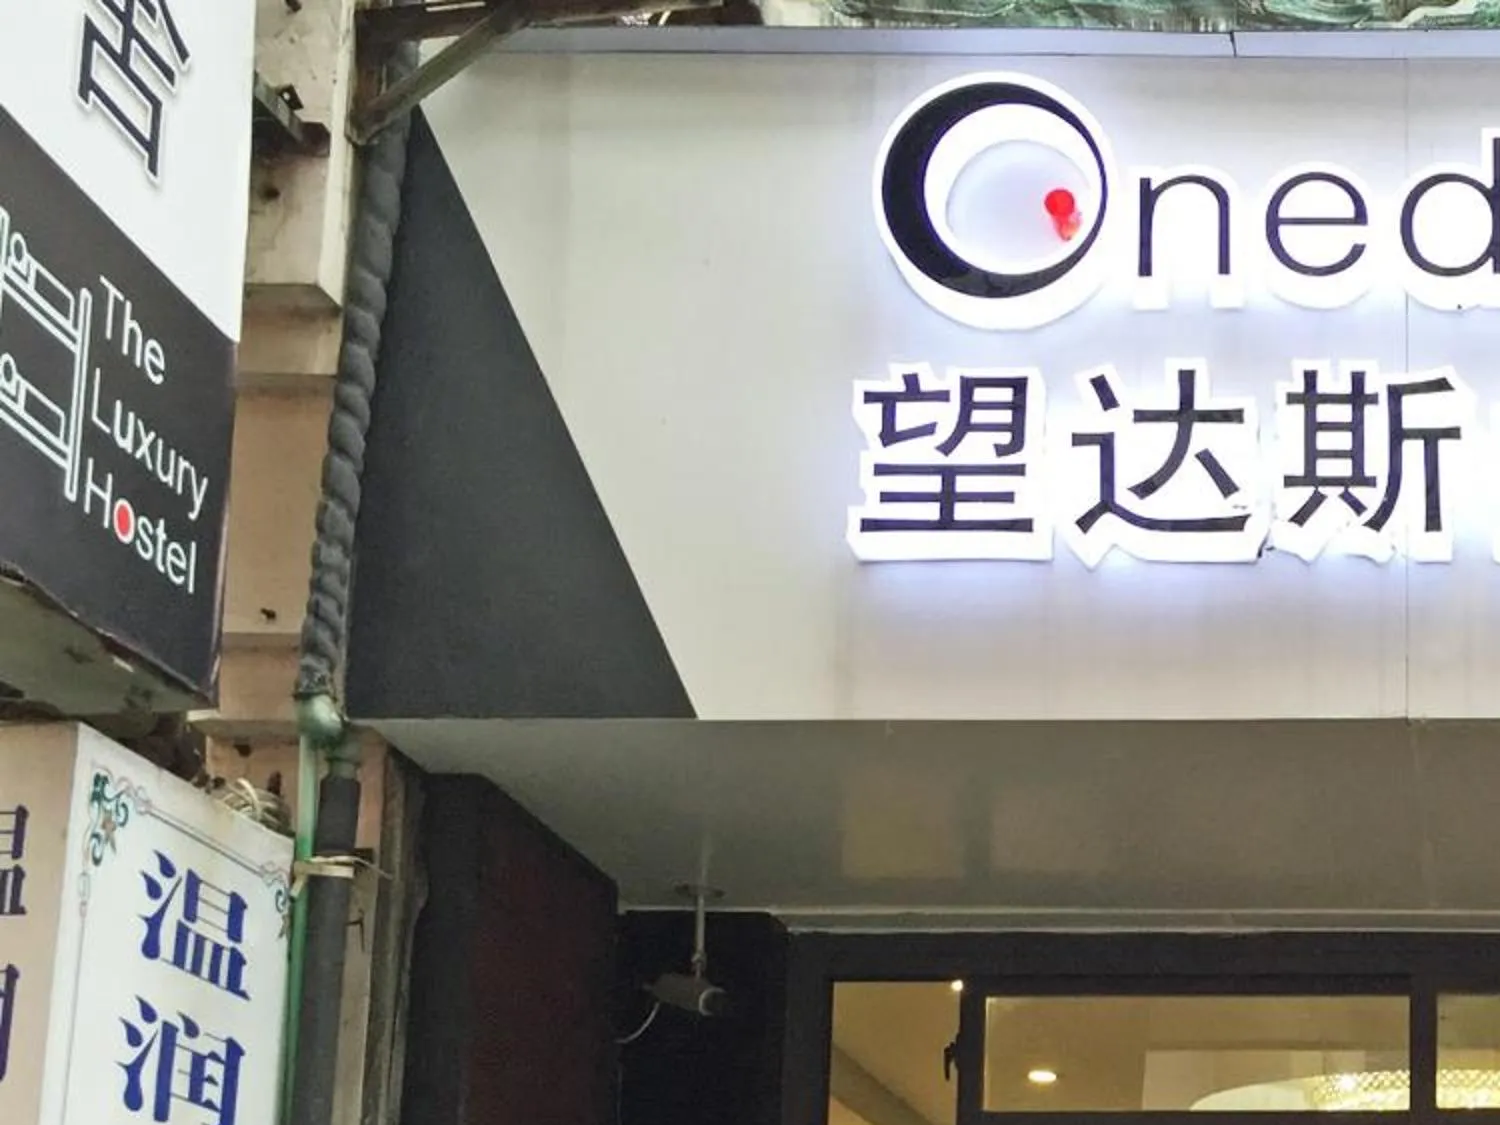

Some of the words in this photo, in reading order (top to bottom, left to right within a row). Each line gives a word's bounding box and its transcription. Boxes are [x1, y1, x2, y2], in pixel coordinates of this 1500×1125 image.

[100, 275, 165, 385] The
[91, 367, 208, 521] Luxury
[84, 457, 197, 594] Hostel
